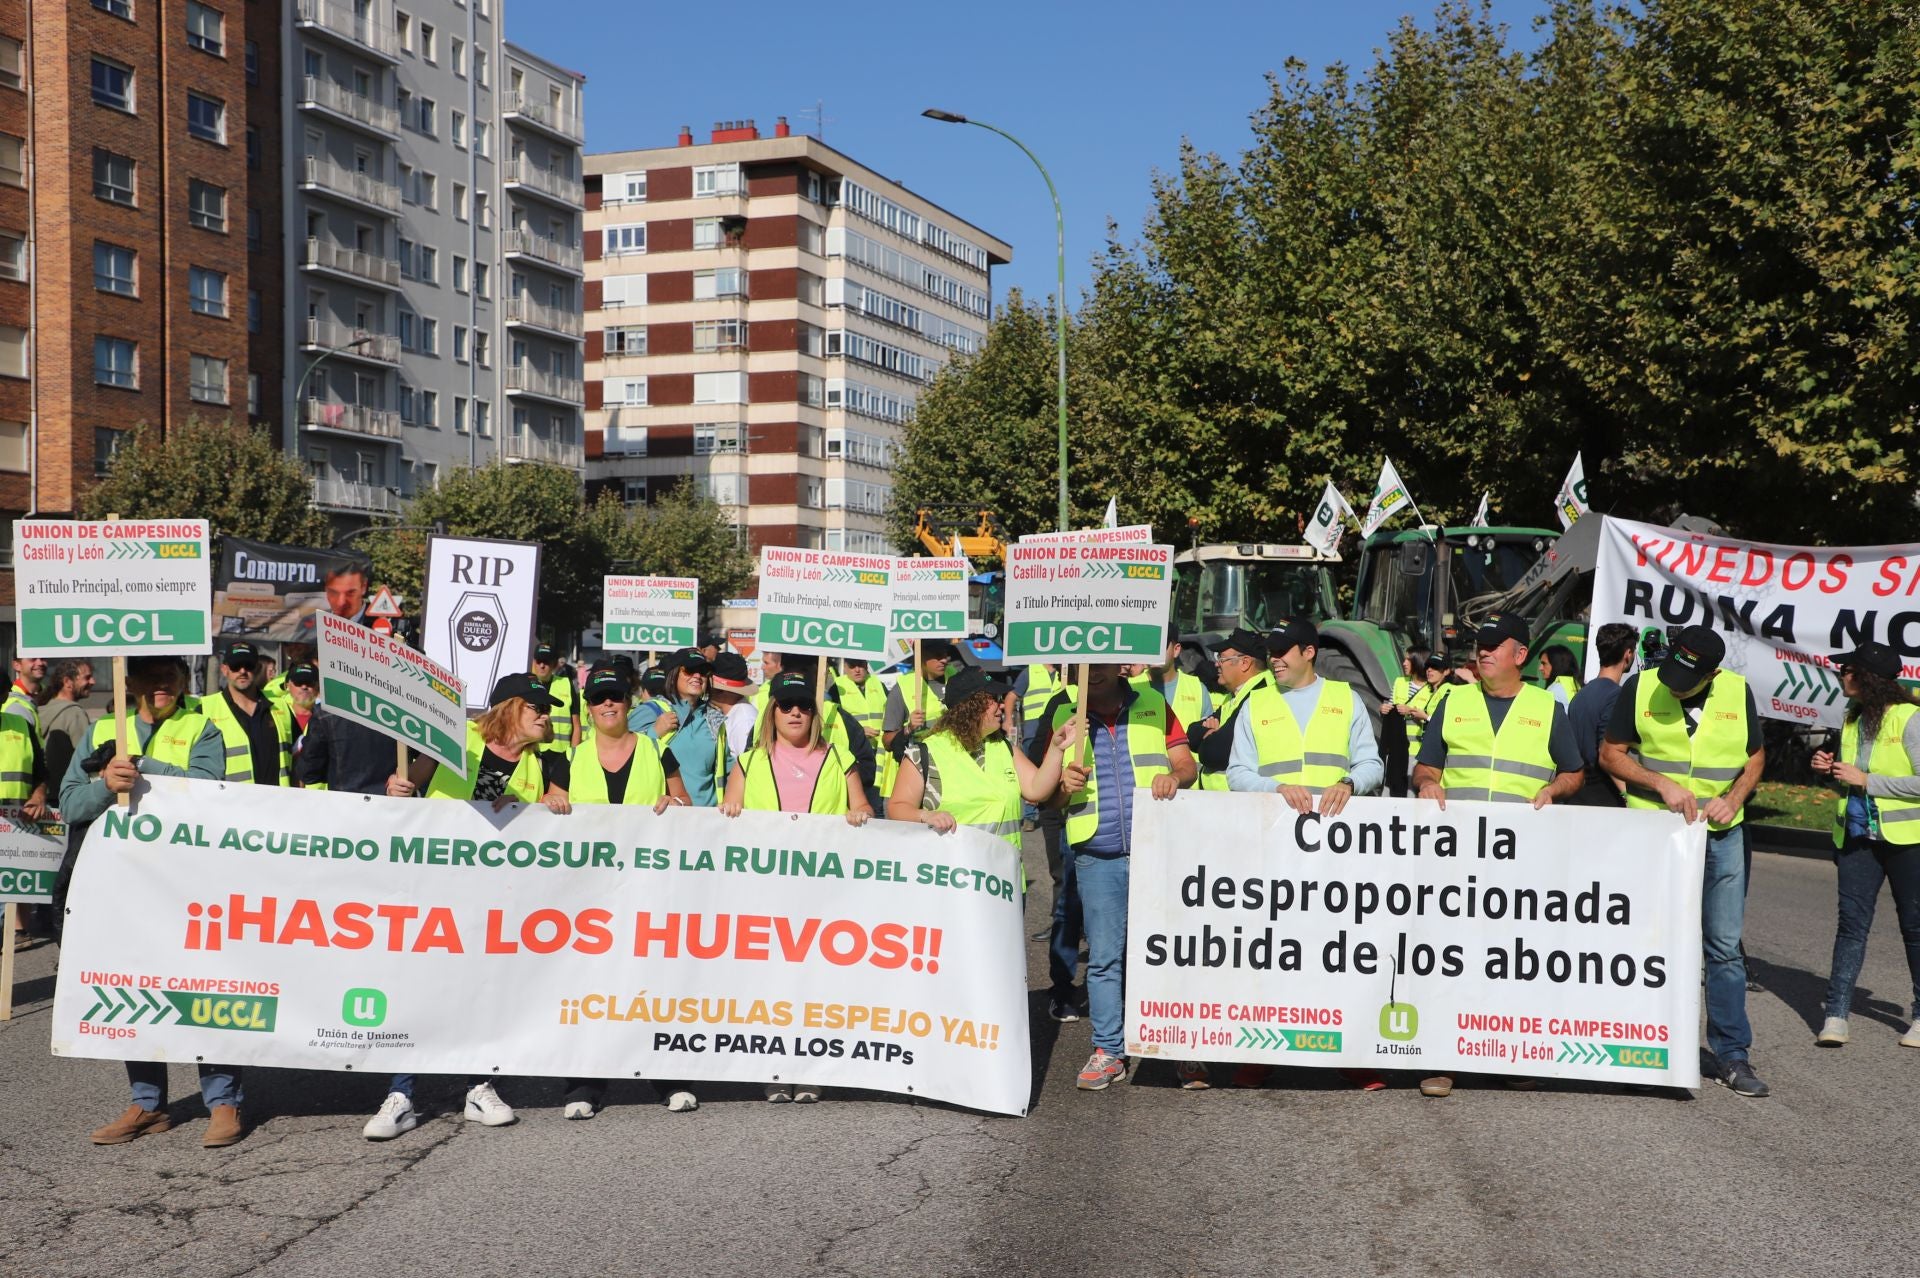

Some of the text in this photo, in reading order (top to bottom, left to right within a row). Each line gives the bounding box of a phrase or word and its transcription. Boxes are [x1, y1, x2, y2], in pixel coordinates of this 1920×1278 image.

[22, 525, 202, 538] UNION DE CAMPESINOS
[24, 544, 103, 564] Castilla y León
[160, 544, 197, 557] UCCL
[767, 550, 890, 570] UNION DE CAMPESINOS
[1014, 548, 1167, 562] UNION DE CAMPESINOS
[450, 554, 514, 586] RIP
[767, 564, 821, 581] Castilla y León
[911, 560, 964, 568] CAMPESINOS
[1014, 564, 1080, 582] Castilla y León
[1128, 566, 1160, 578] UCCL
[1526, 559, 1549, 586] MX
[1632, 535, 1853, 594] VIÑEDOS
[648, 580, 694, 588] CAMPESINOS
[860, 573, 885, 584] UCCL
[897, 571, 911, 581] León
[29, 578, 196, 596] a Título Principal, como siempre
[608, 589, 628, 598] Castilla
[635, 589, 647, 598] León
[938, 592, 960, 601] siempre
[774, 592, 794, 604] Título
[797, 593, 831, 608] Principal,
[833, 600, 852, 608] como
[854, 598, 882, 612] siempre
[1016, 595, 1157, 611] a Título Principal, como siempre
[1624, 579, 1796, 644] RUINA
[672, 610, 690, 619] siempre
[55, 613, 173, 643] UCCL
[464, 627, 492, 635] DUERO
[622, 627, 678, 644] UCCL
[782, 620, 863, 647] UCCL
[325, 630, 390, 666] Castilla y León
[1034, 626, 1132, 652] UCCL
[324, 616, 462, 693] UNION DE CAMPESINOS
[1775, 648, 1811, 664] UNION
[1814, 655, 1830, 668] DE
[330, 660, 335, 668] a
[337, 660, 363, 678] Título
[406, 693, 427, 708] como
[429, 704, 457, 729] siempre
[432, 679, 458, 704] UCCL
[1772, 699, 1818, 718] Burgos
[351, 691, 441, 752] UCCL
[1294, 812, 1516, 860] Contra la
[22, 848, 62, 861] como siempre
[103, 810, 1013, 902] NO AL ACUERDO MERCOSUR, ES LA RUINA DEL SECTOR
[1181, 864, 1631, 926] desproporcionada
[184, 894, 942, 974] ¡¡HASTA LOS HUEVOS!!
[1146, 924, 1666, 988] subida de los abonos
[80, 972, 280, 995] UNION DE CAMPESINOS
[191, 998, 266, 1029] UCCL
[559, 990, 1000, 1050] ¡¡CLÁUSULAS ESPEJO YA!!
[1141, 1001, 1343, 1026] UNION DE CAMPESINOS
[79, 1022, 136, 1039] Burgos
[317, 1028, 409, 1040] Unión de Uniones
[1140, 1023, 1232, 1049] Castilla y León
[1458, 1013, 1668, 1042] UNION DE CAMPESINOS
[320, 1040, 365, 1048] Agricultores
[653, 1032, 914, 1065] PAC PARA LOS ATPs
[1295, 1033, 1337, 1050] UCCL
[1376, 1044, 1422, 1055] La Unión
[1457, 1036, 1554, 1063] Castilla y León
[1618, 1048, 1664, 1067] UCCL
